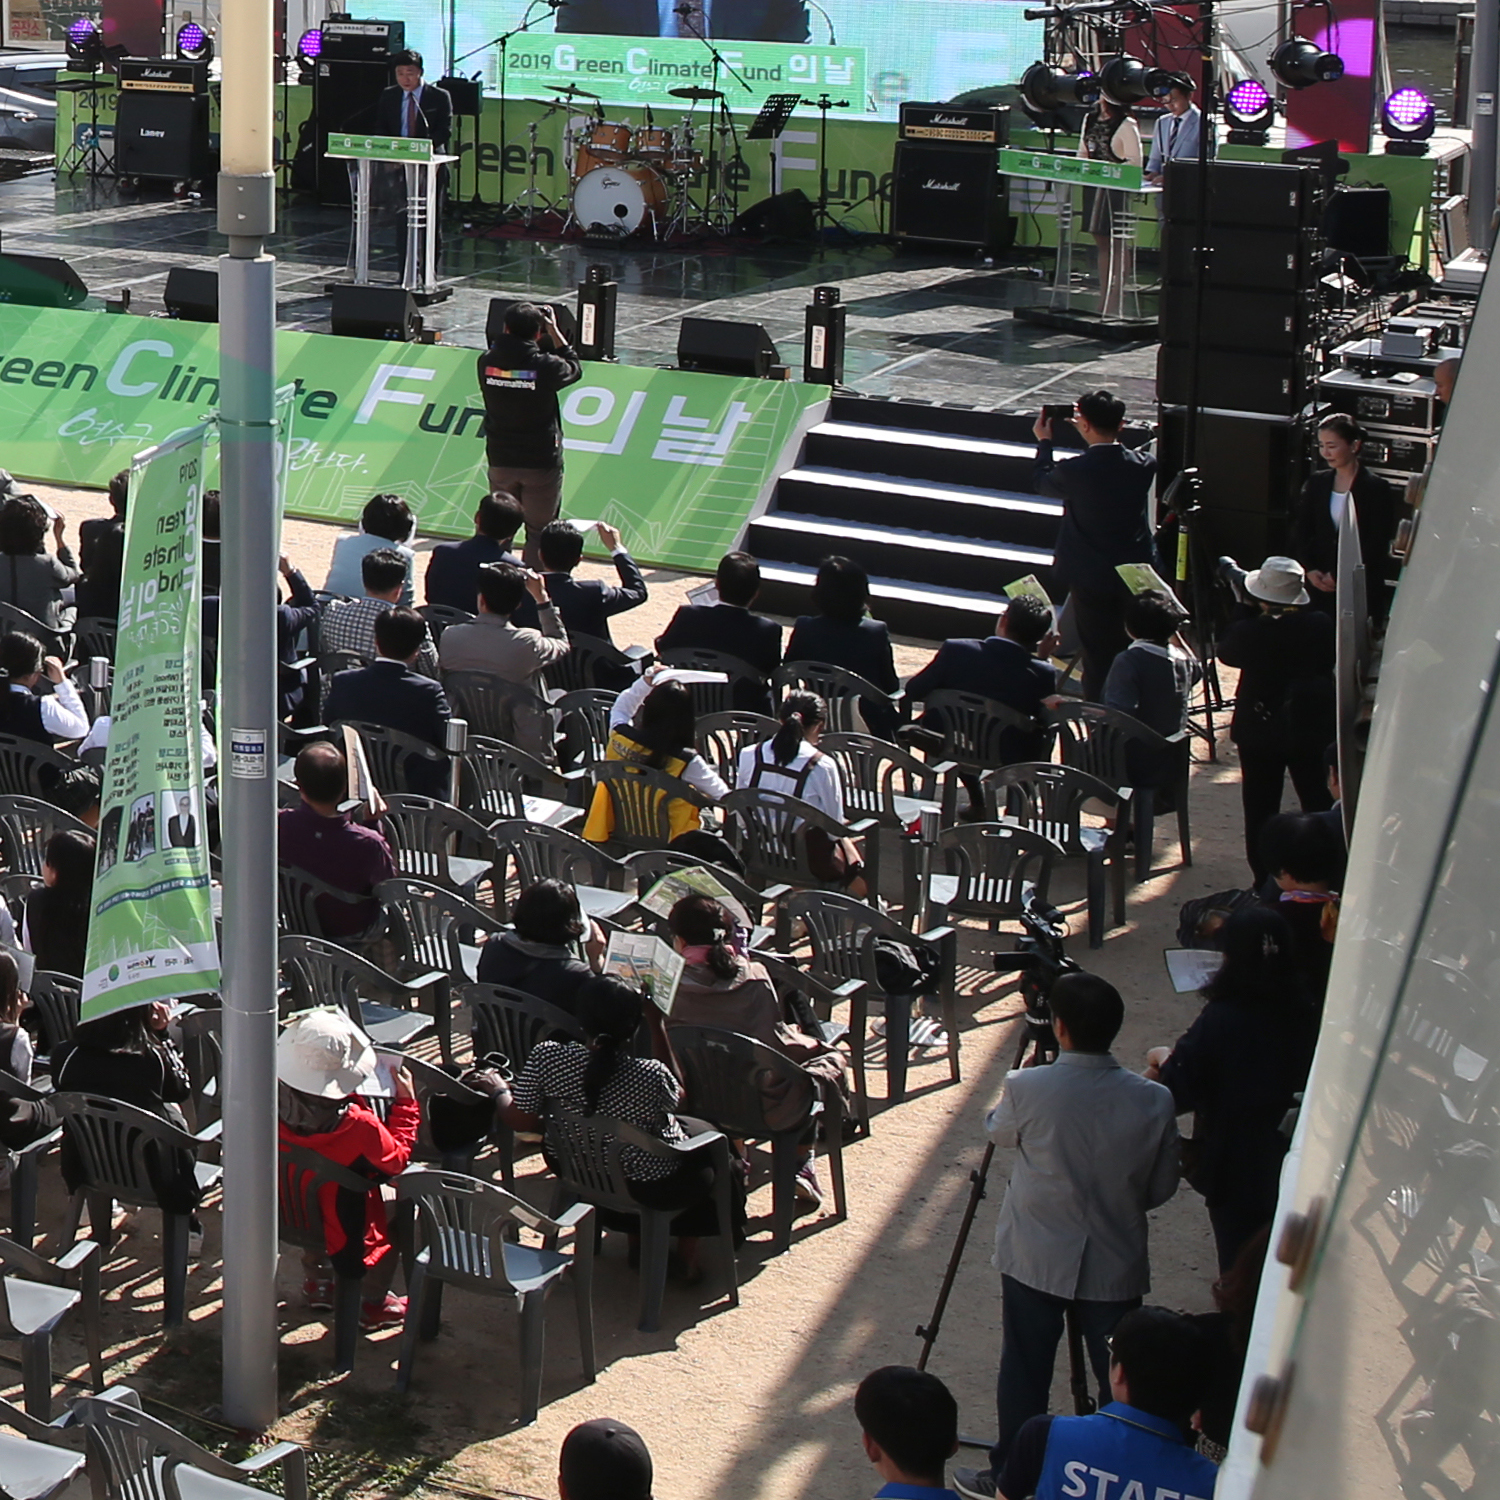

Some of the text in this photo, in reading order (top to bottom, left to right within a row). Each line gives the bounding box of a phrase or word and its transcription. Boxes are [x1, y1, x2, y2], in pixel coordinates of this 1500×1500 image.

[140, 68, 173, 79] Marshall
[509, 44, 856, 86] 2019 Green Climate Fund 의 날
[79, 91, 118, 111] 2019
[929, 113, 968, 126] Marshall
[922, 179, 960, 191] Marshall
[105, 339, 338, 422] Climte
[353, 363, 486, 439] Fun
[562, 386, 646, 455] 의
[651, 394, 753, 466] 날
[1061, 1460, 1206, 1500] STA
